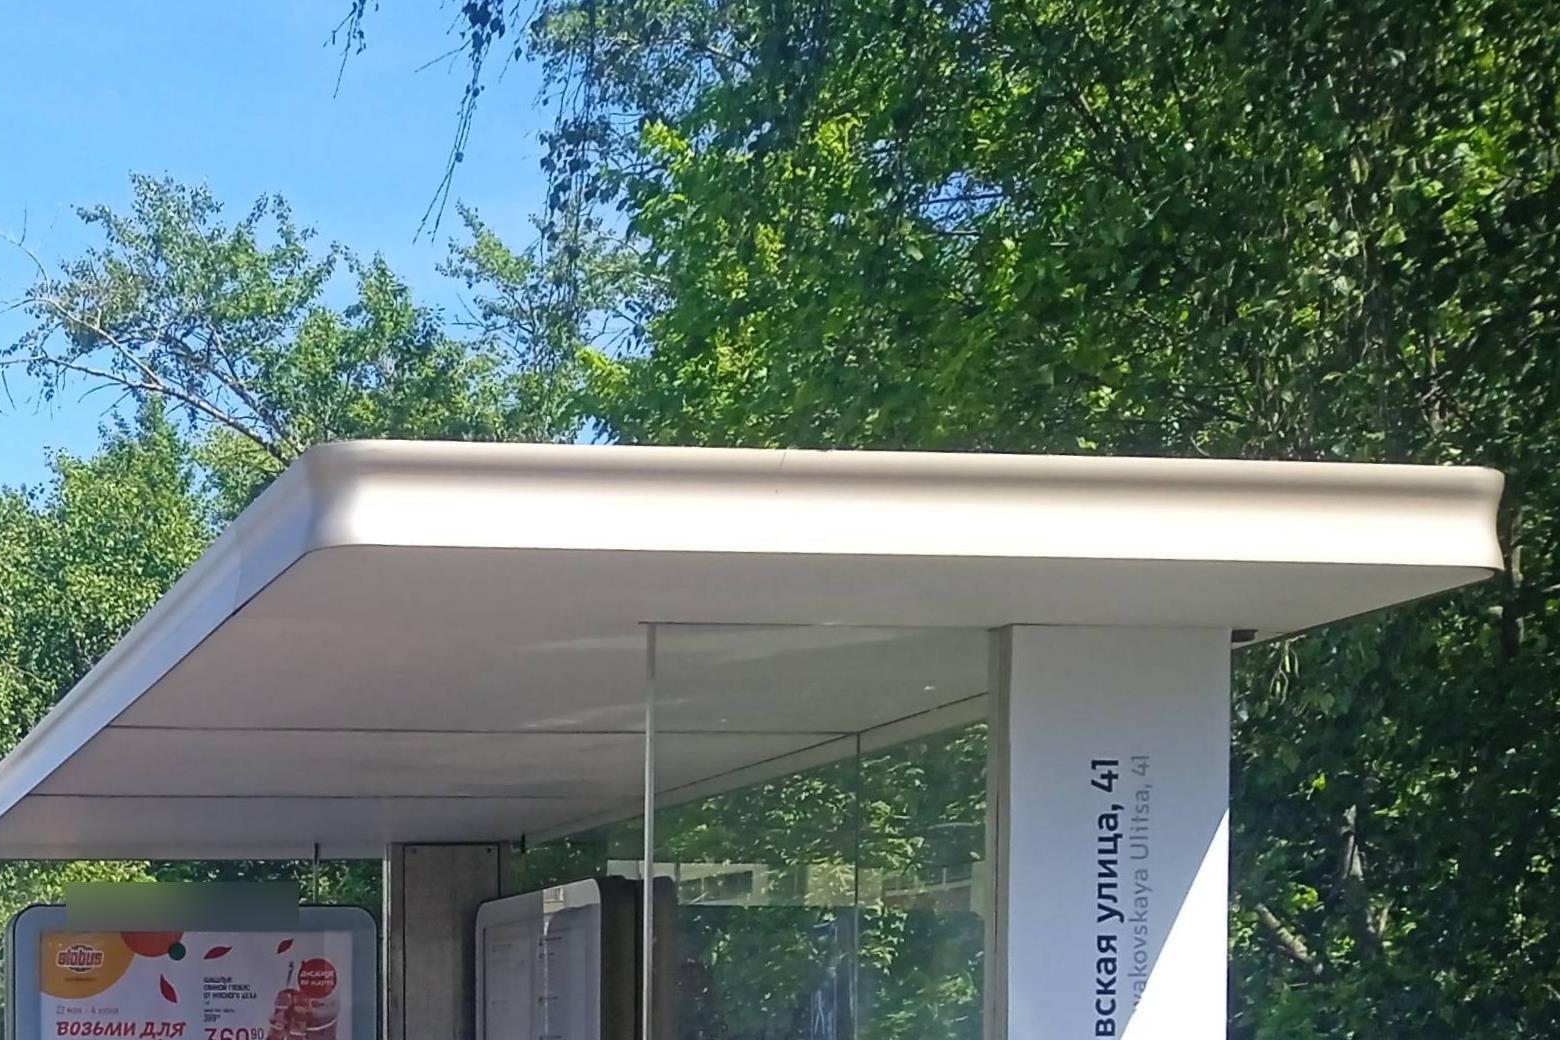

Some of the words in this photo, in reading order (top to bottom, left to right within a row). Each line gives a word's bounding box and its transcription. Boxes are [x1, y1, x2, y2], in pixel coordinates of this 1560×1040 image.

[1091, 759, 1120, 793] 41
[1130, 755, 1150, 777] 41
[1128, 783, 1153, 860] Ulitsa,
[1096, 803, 1125, 924] улица,
[56, 1021, 137, 1037] ВОЗЬМИ
[139, 1021, 187, 1040] ДЛЯ
